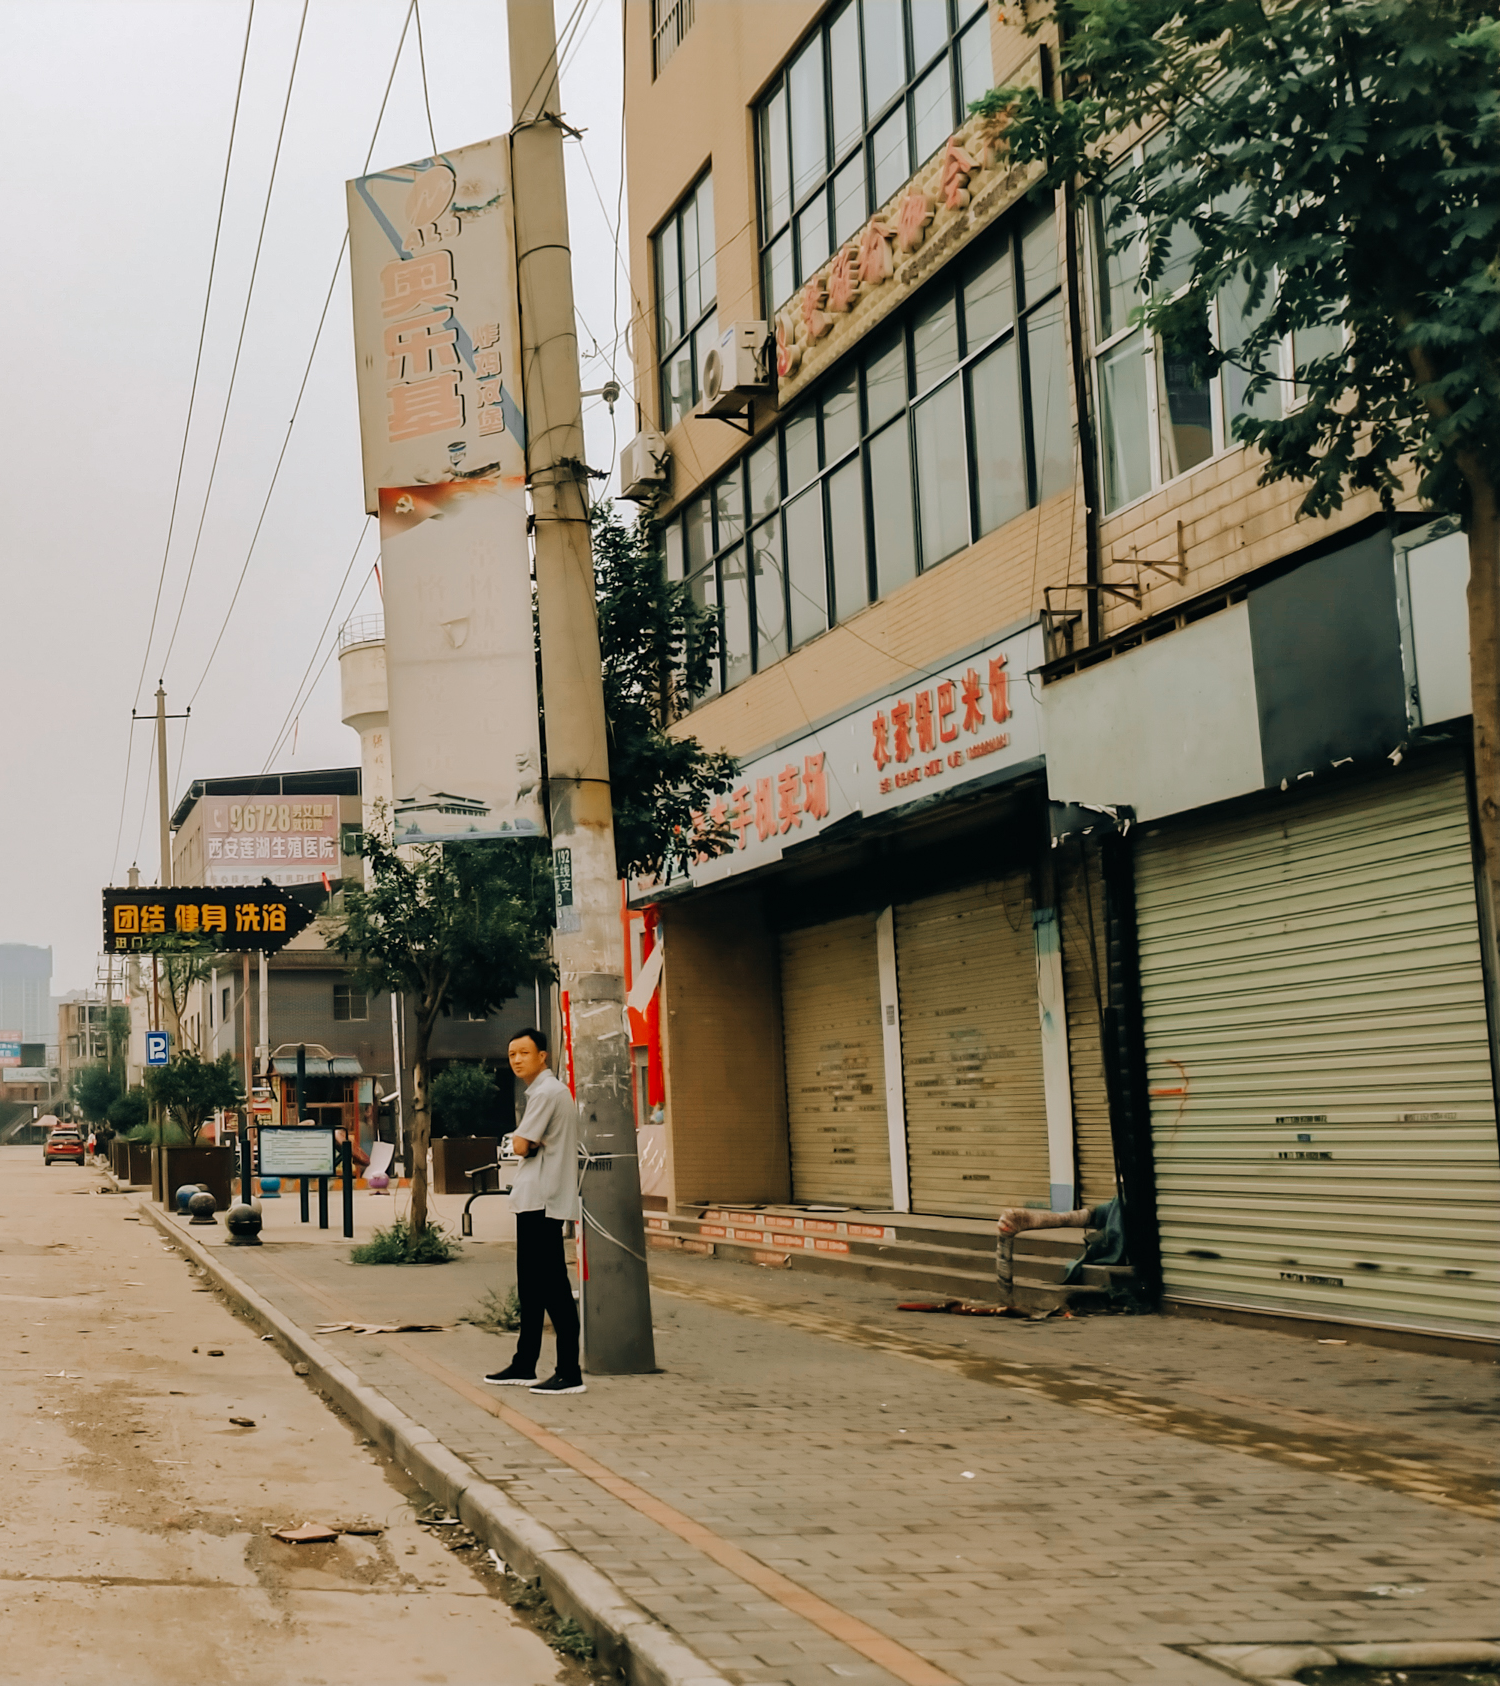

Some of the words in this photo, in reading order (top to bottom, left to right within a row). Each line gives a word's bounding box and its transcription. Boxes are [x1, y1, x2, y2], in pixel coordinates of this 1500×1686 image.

[230, 804, 290, 833] 96728
[208, 836, 334, 859] 西安莲湖生殖医院
[113, 904, 166, 934] 团结
[175, 904, 227, 933] 健身
[235, 904, 287, 932] 洗浴
[149, 1036, 167, 1060] P
